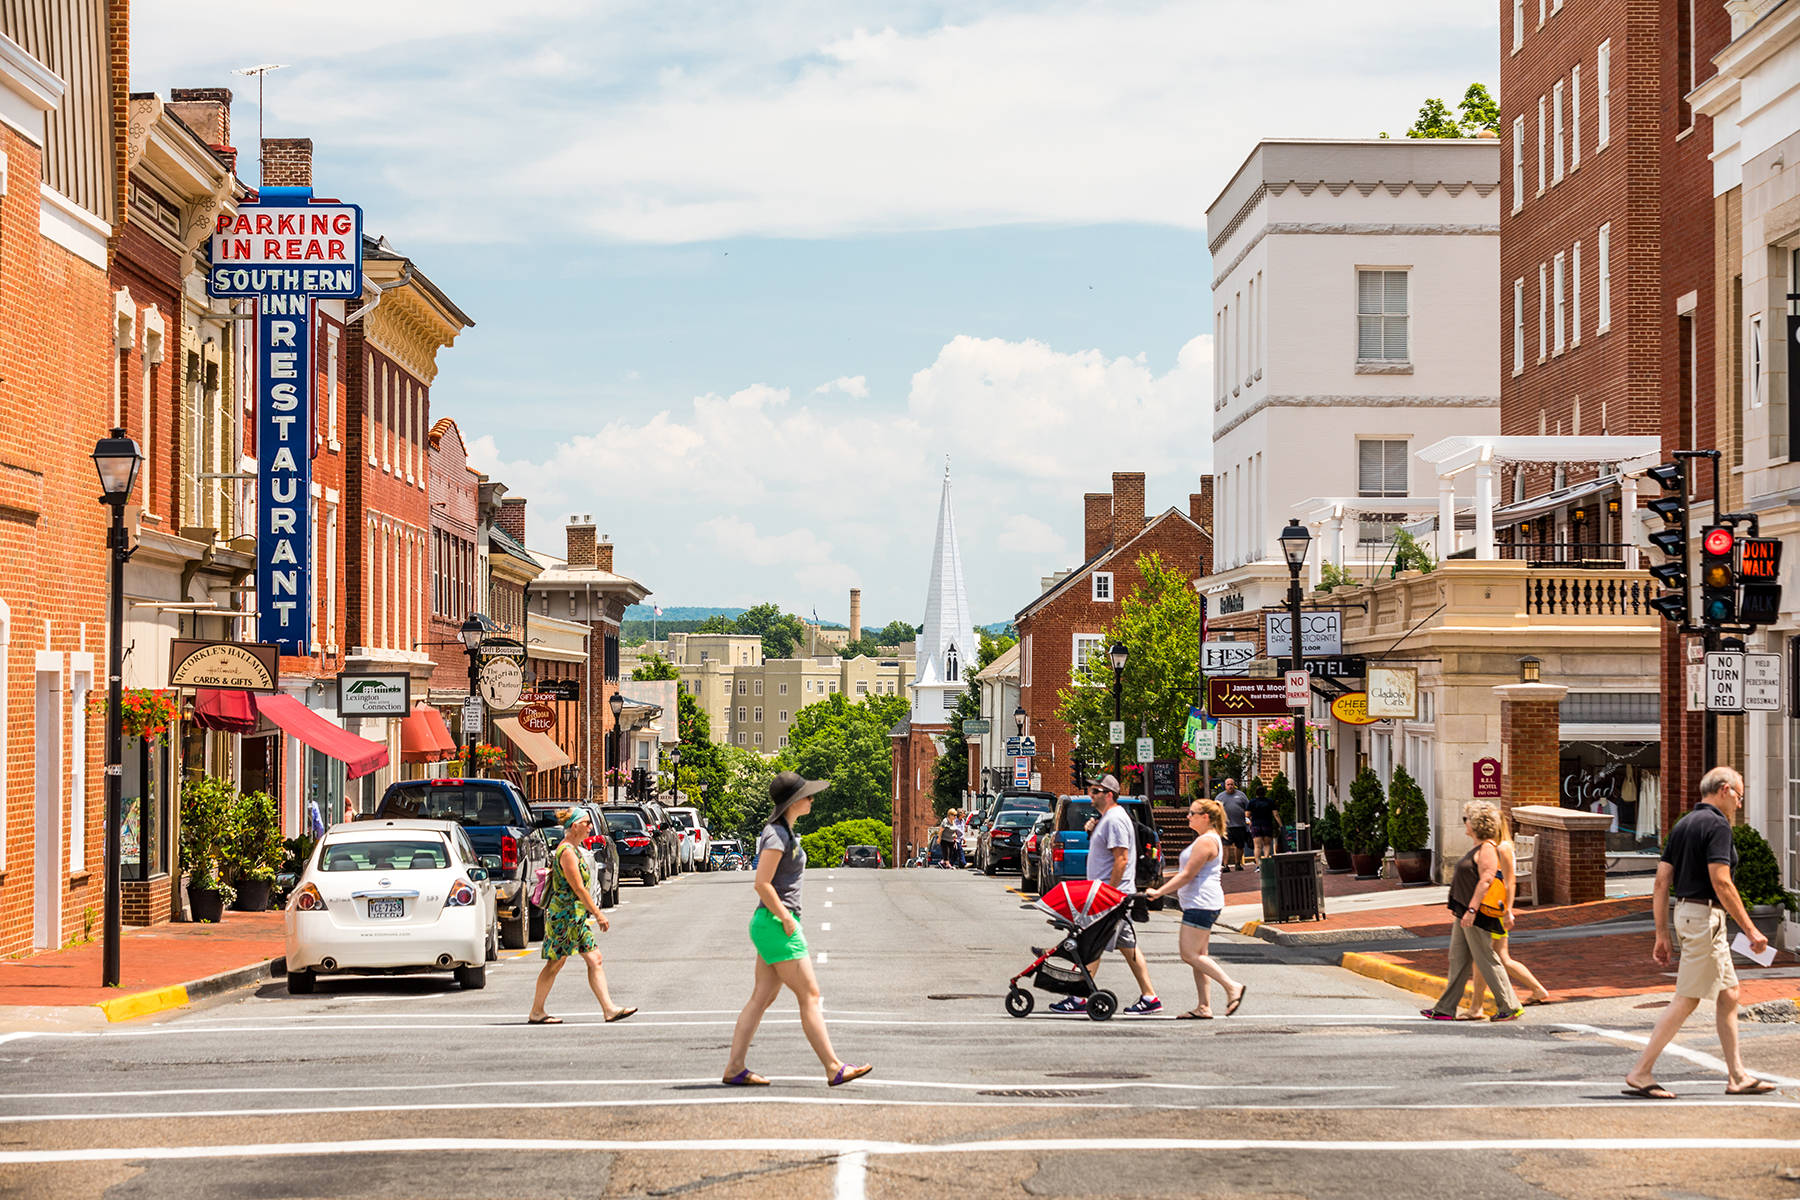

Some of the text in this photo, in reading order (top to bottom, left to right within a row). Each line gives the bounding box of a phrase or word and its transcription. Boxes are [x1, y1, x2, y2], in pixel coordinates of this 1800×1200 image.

[216, 214, 352, 235] PARKING
[222, 239, 346, 260] IN REAR
[215, 269, 352, 291] SOUTHERN
[262, 294, 306, 315] INN
[270, 320, 298, 627] RESTAURANT
[1742, 560, 1774, 576] WALK
[1271, 634, 1336, 643] BAR STORANTE
[1207, 649, 1253, 666] HESS
[1718, 657, 1733, 667] NO
[228, 647, 271, 687] HALLMARK
[1304, 661, 1349, 675] OTEL
[193, 675, 220, 684] CARDS
[231, 678, 253, 686] GIFTS
[1711, 670, 1739, 680] TURN
[1290, 677, 1304, 687] NO
[1718, 683, 1732, 693] ON
[345, 693, 379, 702] Lexington
[1287, 691, 1309, 699] PARKING
[1338, 700, 1366, 708] CHEE
[1714, 696, 1735, 706] RED
[530, 718, 551, 728] Attic
[1563, 774, 1616, 808] Glad
